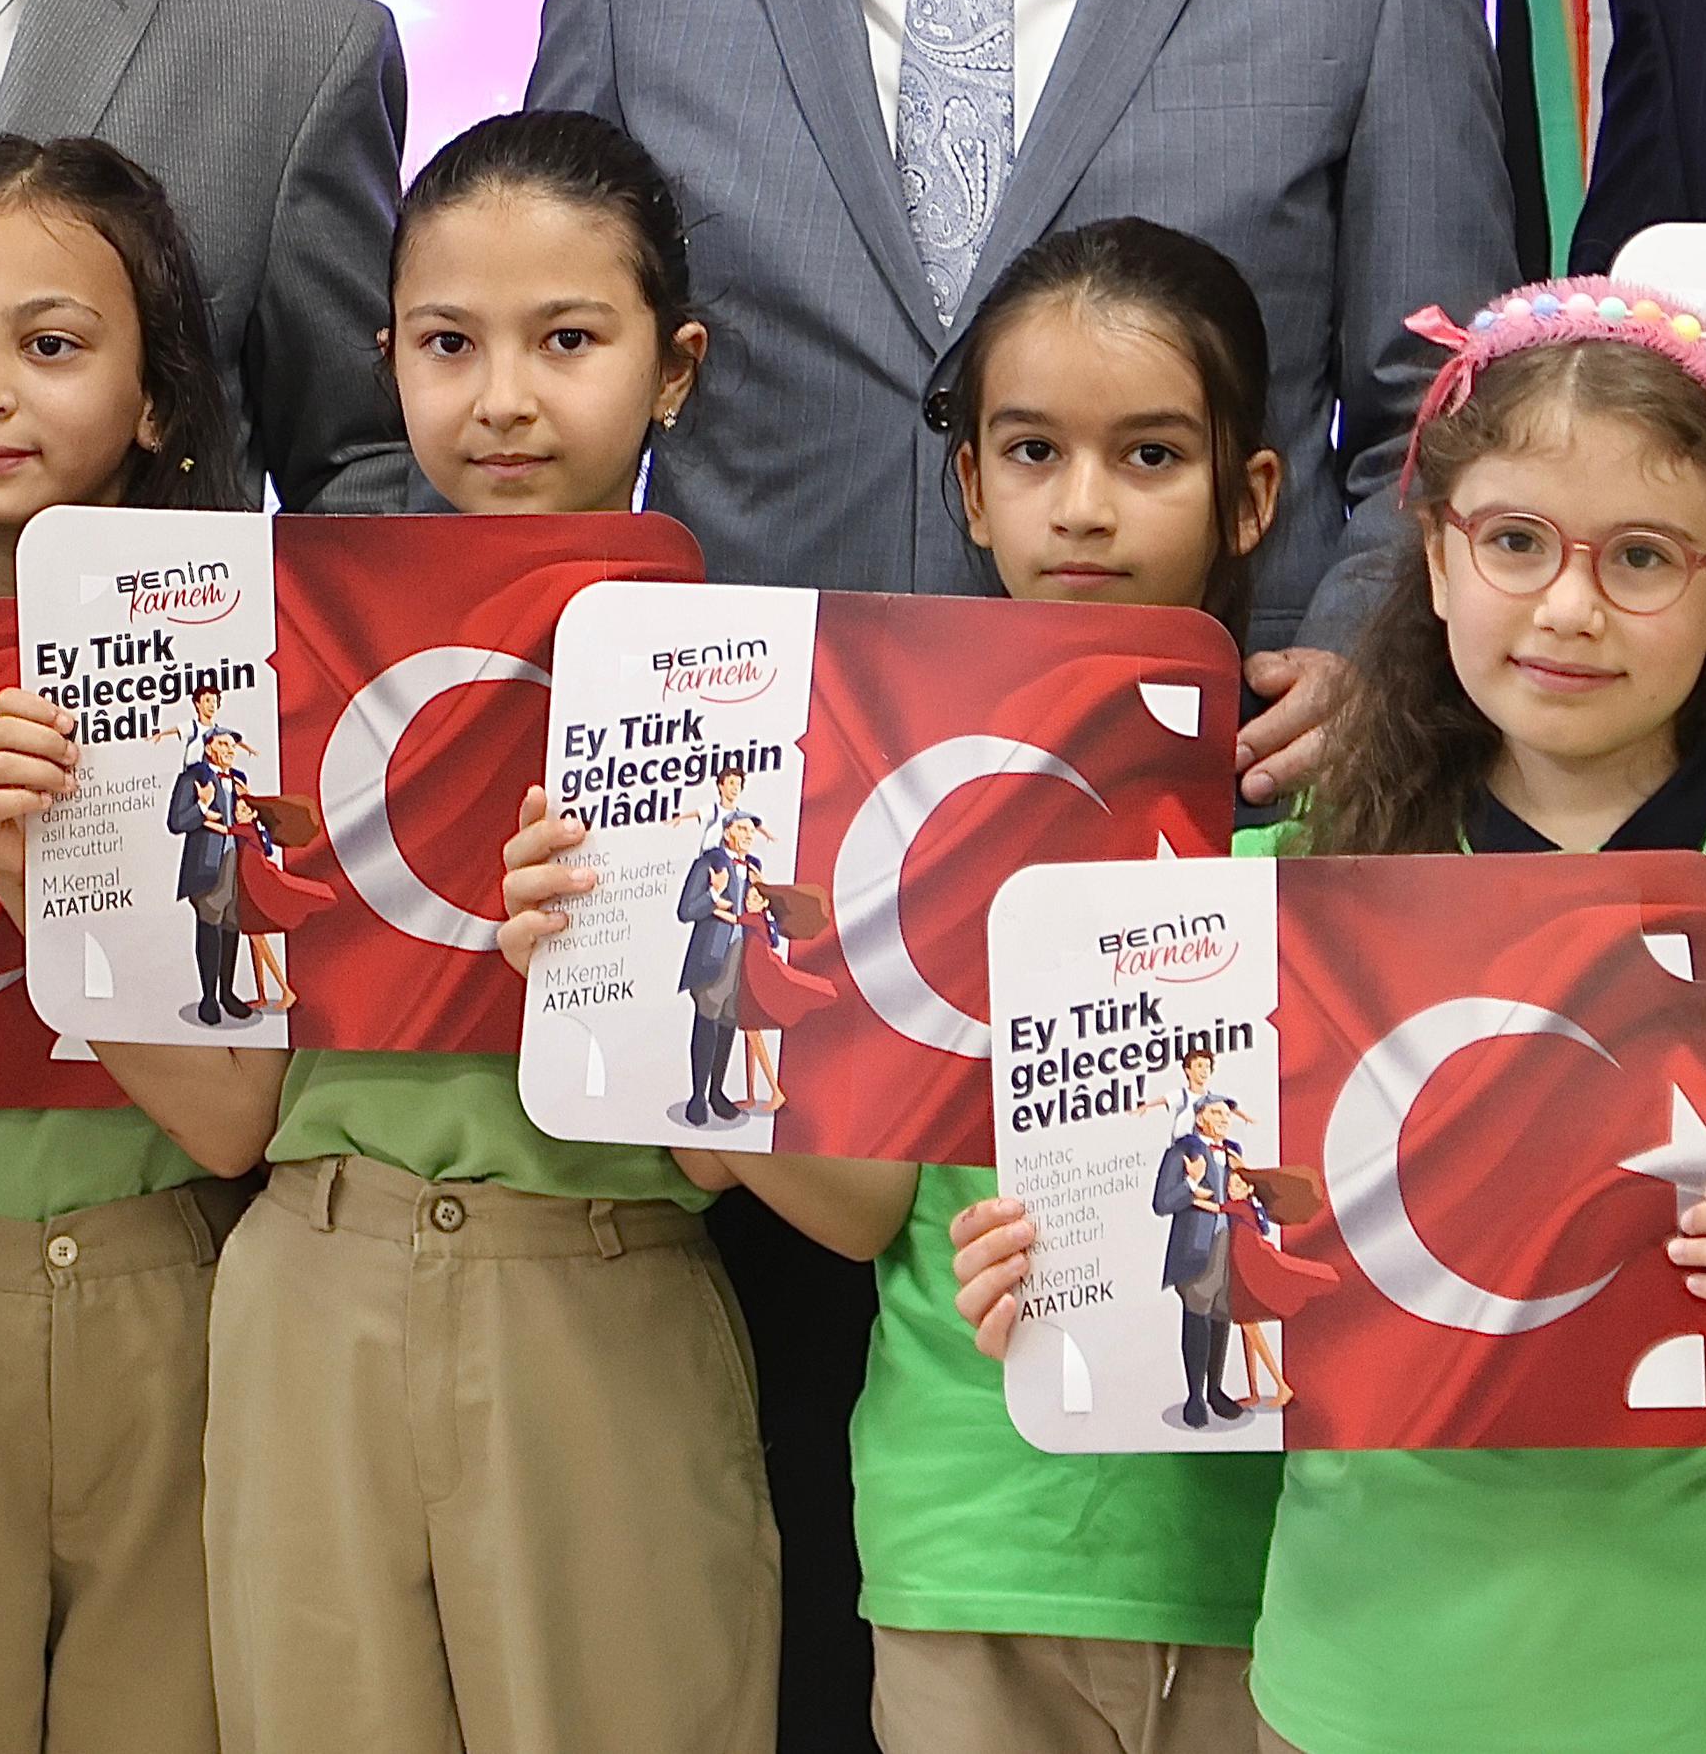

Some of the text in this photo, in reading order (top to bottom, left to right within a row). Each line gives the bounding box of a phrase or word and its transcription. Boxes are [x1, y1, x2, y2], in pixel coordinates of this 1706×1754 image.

[130, 570, 226, 624] karnem
[37, 629, 174, 679] Ey Türk
[662, 647, 762, 702] karnem
[68, 705, 160, 745] lâdı!
[565, 709, 705, 761] Ey Türk
[561, 739, 782, 802] geleceğinin
[42, 796, 155, 823] damarlarındaki
[42, 836, 123, 862] mevcuttur!
[42, 867, 120, 896] M.Kemal
[43, 888, 133, 919] ATATÜRK
[548, 924, 630, 953] mevcuttur!
[1114, 928, 1222, 986] karnem
[545, 957, 624, 989] M.Kemal
[543, 979, 635, 1013] ATATÜRK
[1011, 991, 1163, 1054] Ey Türk
[1011, 1017, 1253, 1100] geleceğinin
[1011, 1075, 1146, 1134] evlâdı!
[1015, 1148, 1074, 1174] Muhtaç
[1016, 1167, 1081, 1195] olduğun
[1019, 1256, 1101, 1295] M.Kemal
[1021, 1280, 1114, 1321] ATATÜRK
